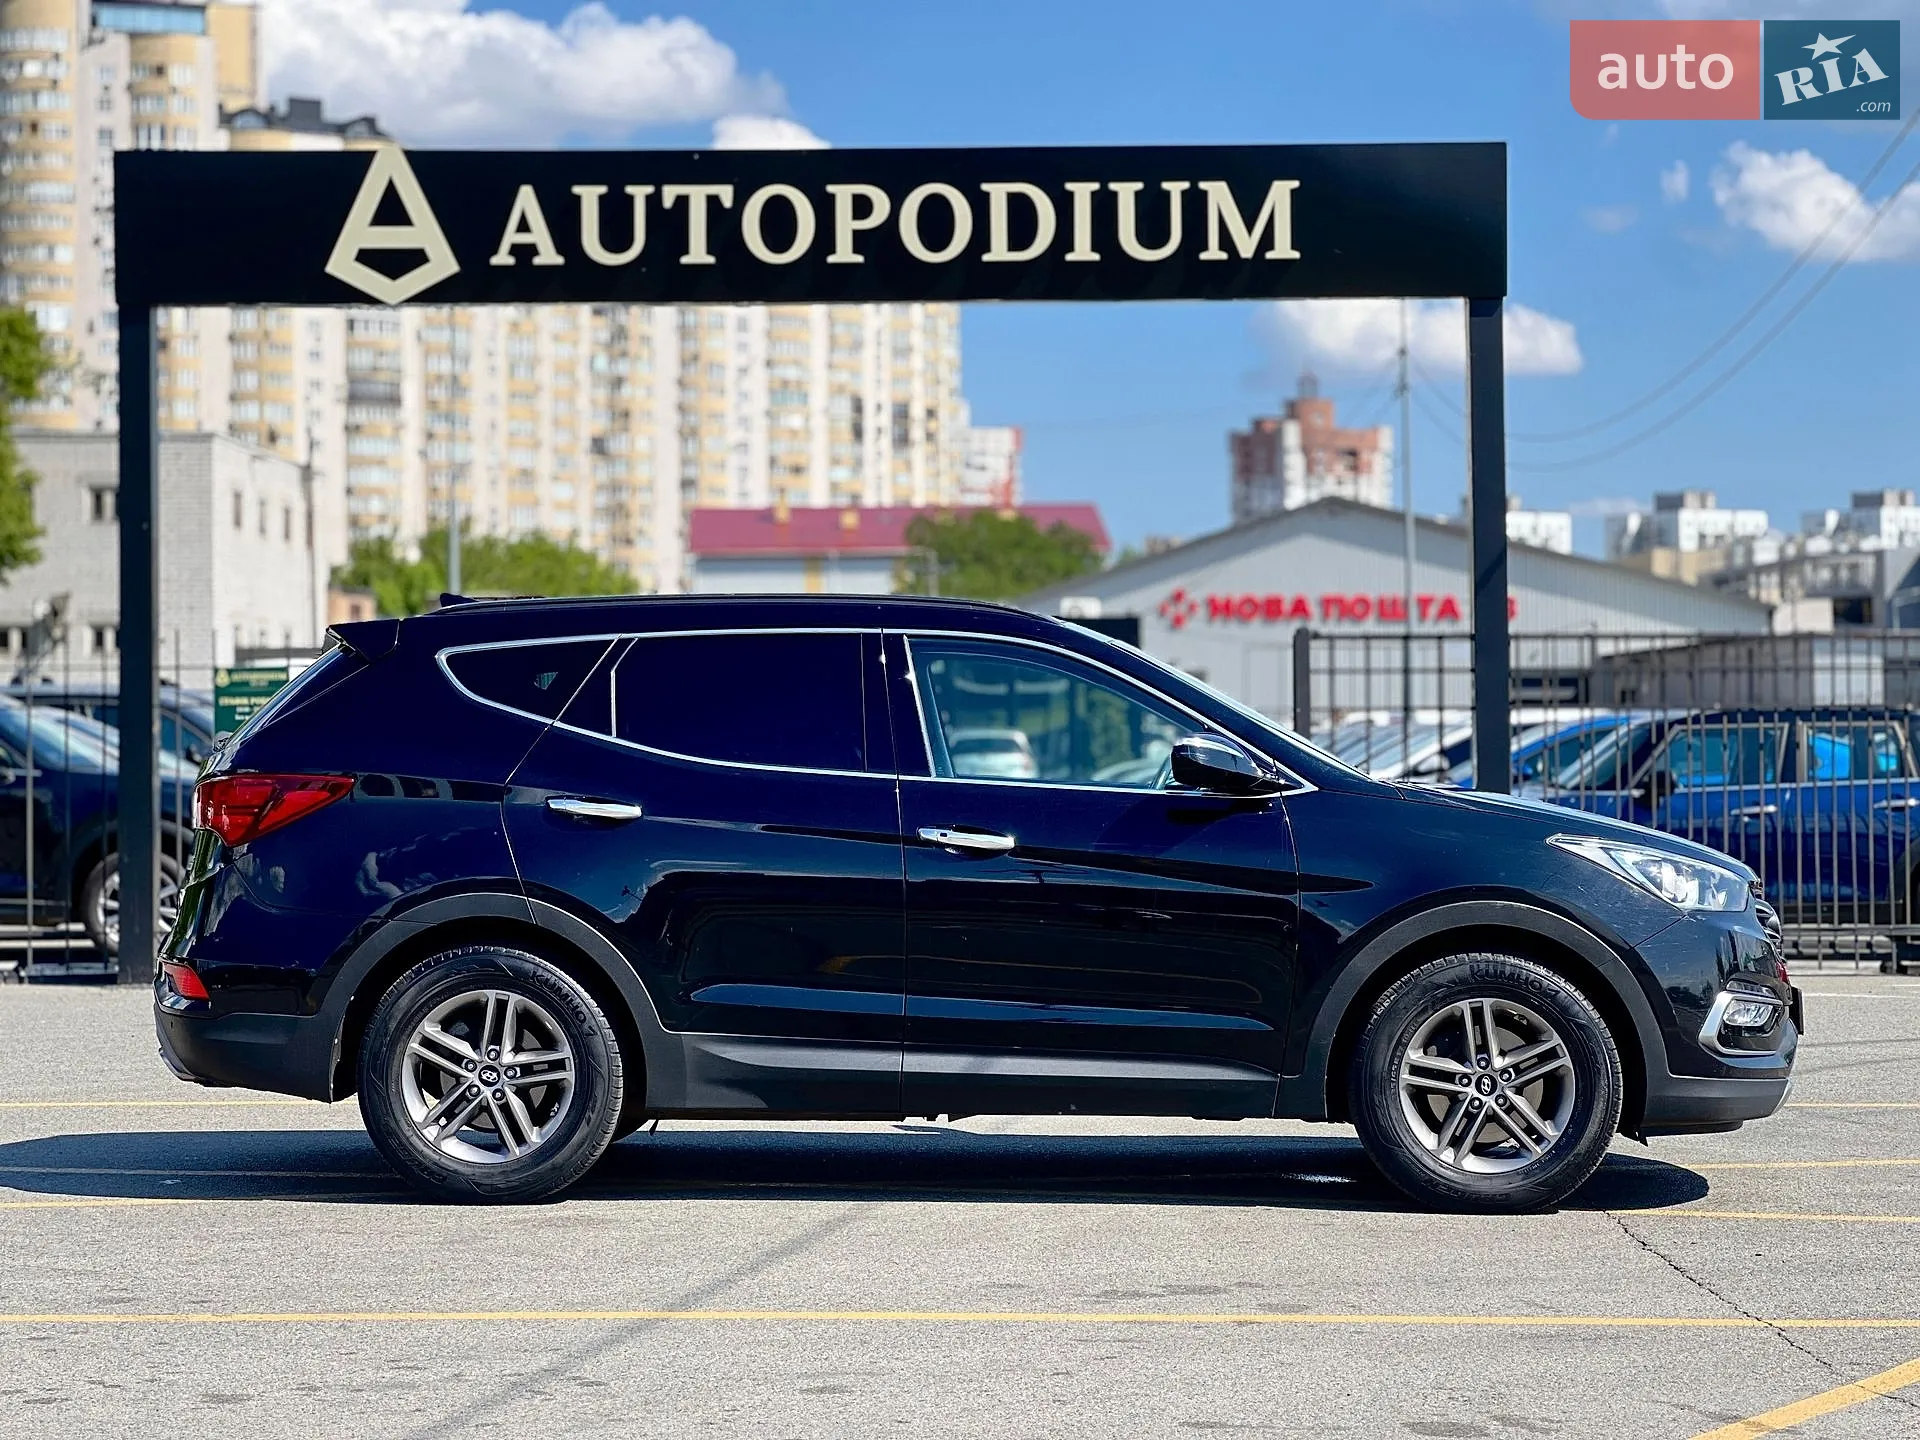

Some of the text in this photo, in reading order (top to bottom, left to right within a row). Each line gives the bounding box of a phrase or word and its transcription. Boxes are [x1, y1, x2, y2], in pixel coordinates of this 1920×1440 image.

[489, 180, 1301, 267] AUTOPODIUM
[1206, 592, 1460, 620] НОВА ПОШТА
[529, 969, 587, 1025] KUMHO
